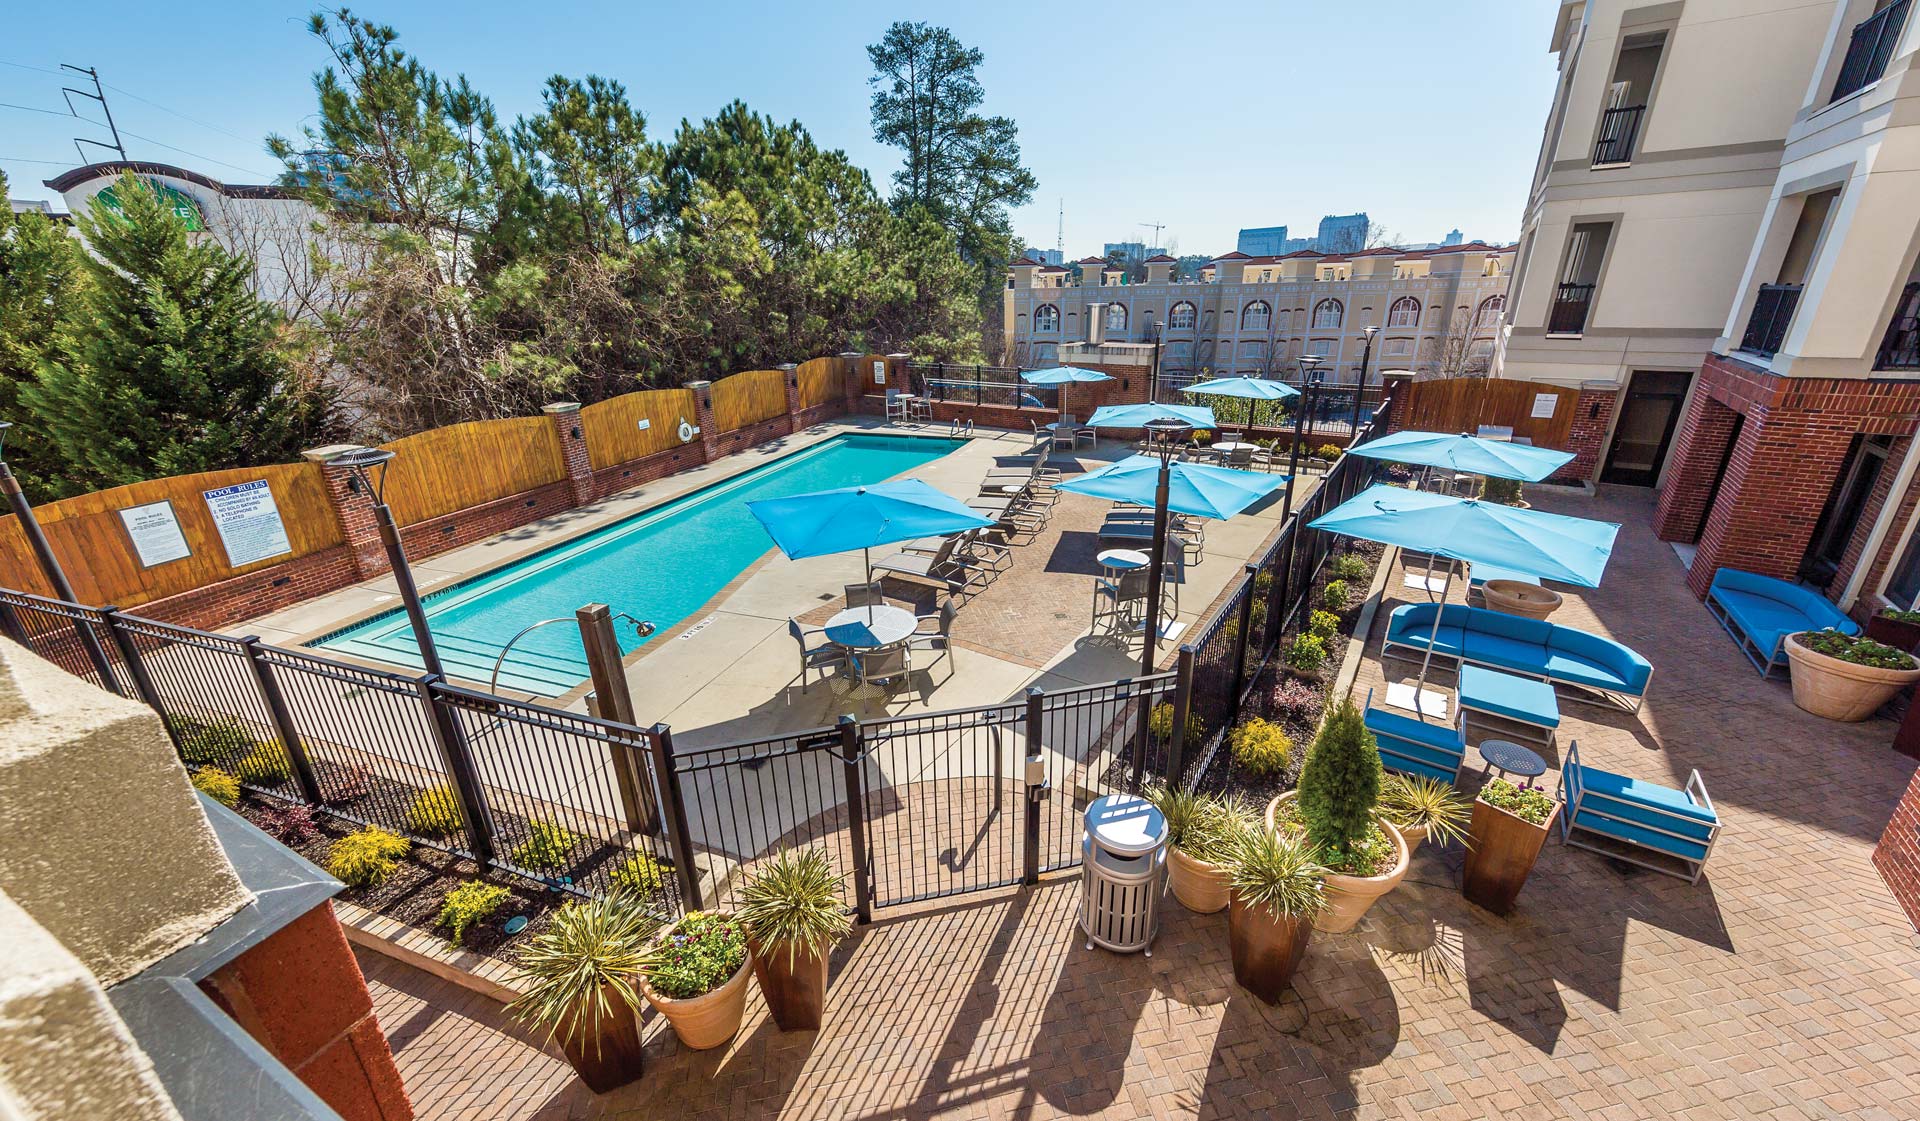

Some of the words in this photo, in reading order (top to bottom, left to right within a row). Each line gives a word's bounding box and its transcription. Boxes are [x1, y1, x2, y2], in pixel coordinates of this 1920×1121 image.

[208, 488, 234, 498] POOL
[238, 481, 265, 491] RULES
[215, 494, 239, 503] CHILDREN
[217, 498, 245, 508] ACCOMPANIED
[225, 507, 252, 516] TELEPHONE
[222, 514, 245, 522] LOCATED
